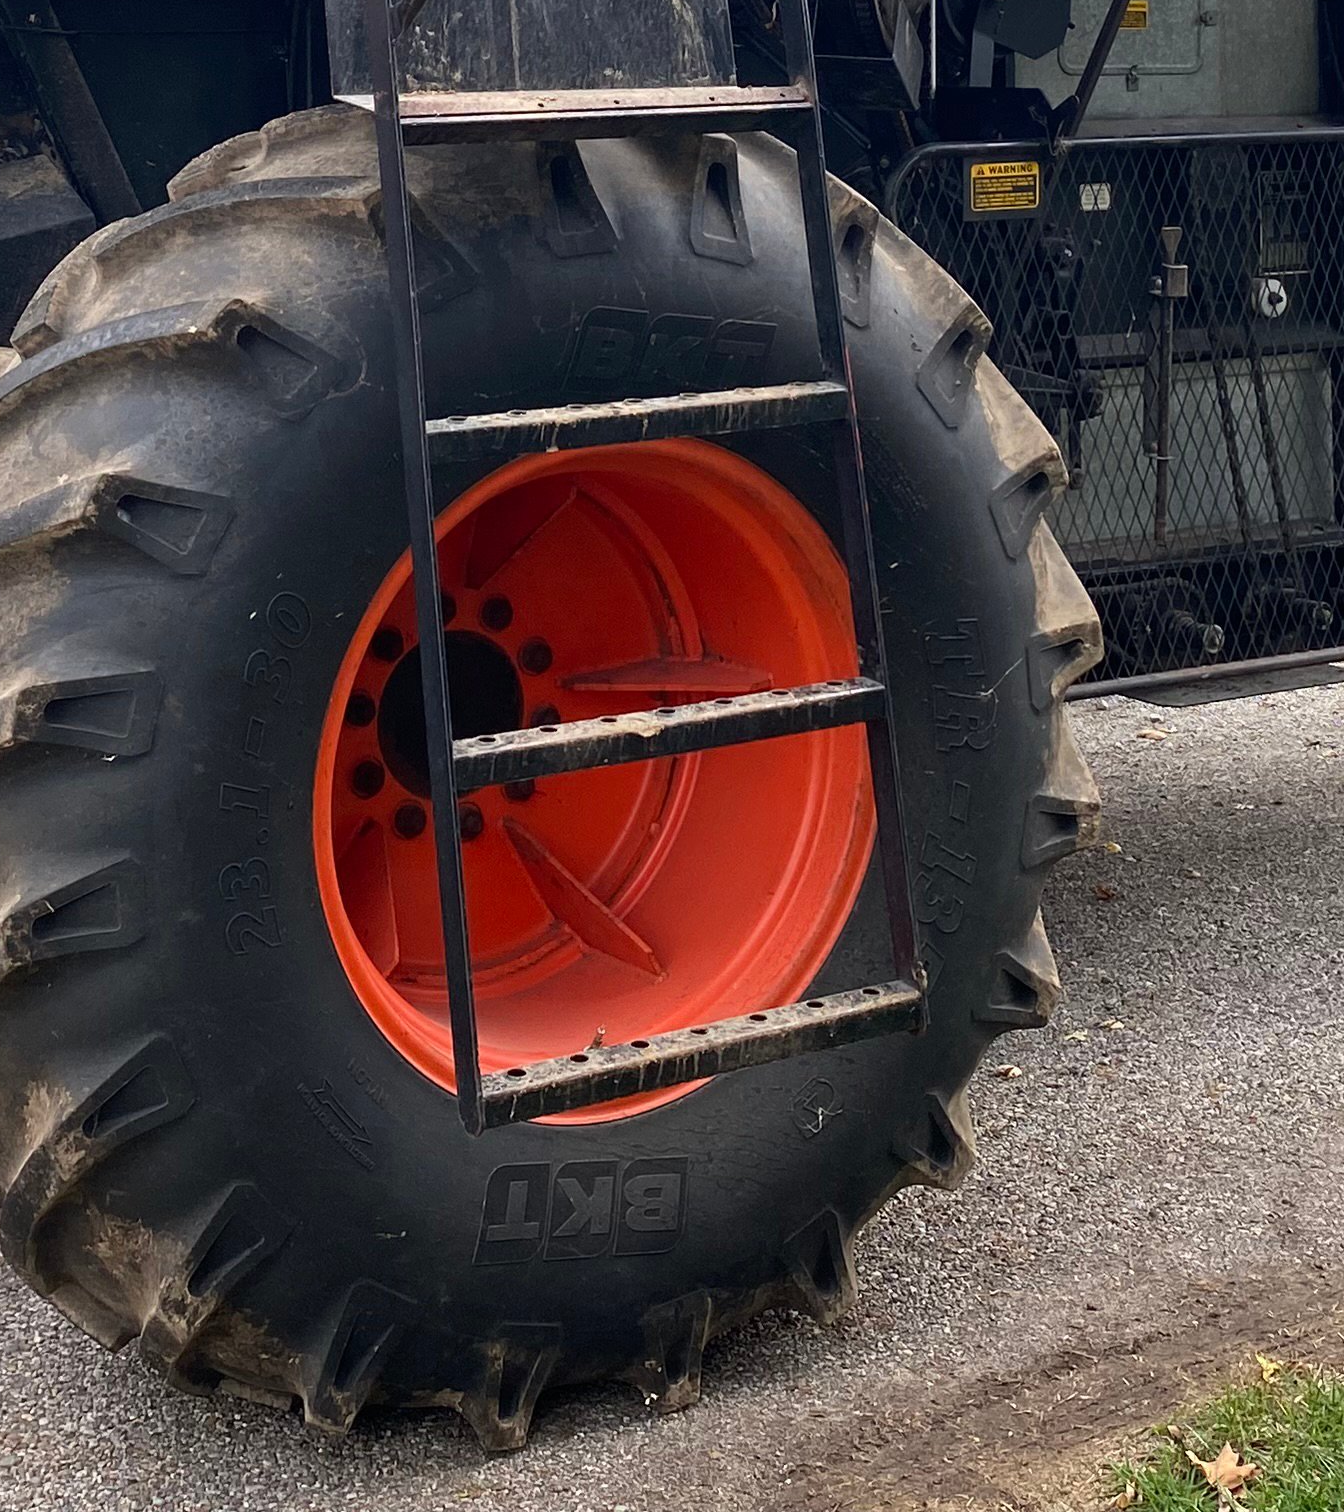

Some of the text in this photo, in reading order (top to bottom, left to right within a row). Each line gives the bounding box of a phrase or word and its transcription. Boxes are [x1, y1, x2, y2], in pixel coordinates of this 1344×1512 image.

[988, 164, 1033, 174] WARNING
[218, 592, 312, 956] 23.1-30
[478, 1163, 686, 1253] BKT
